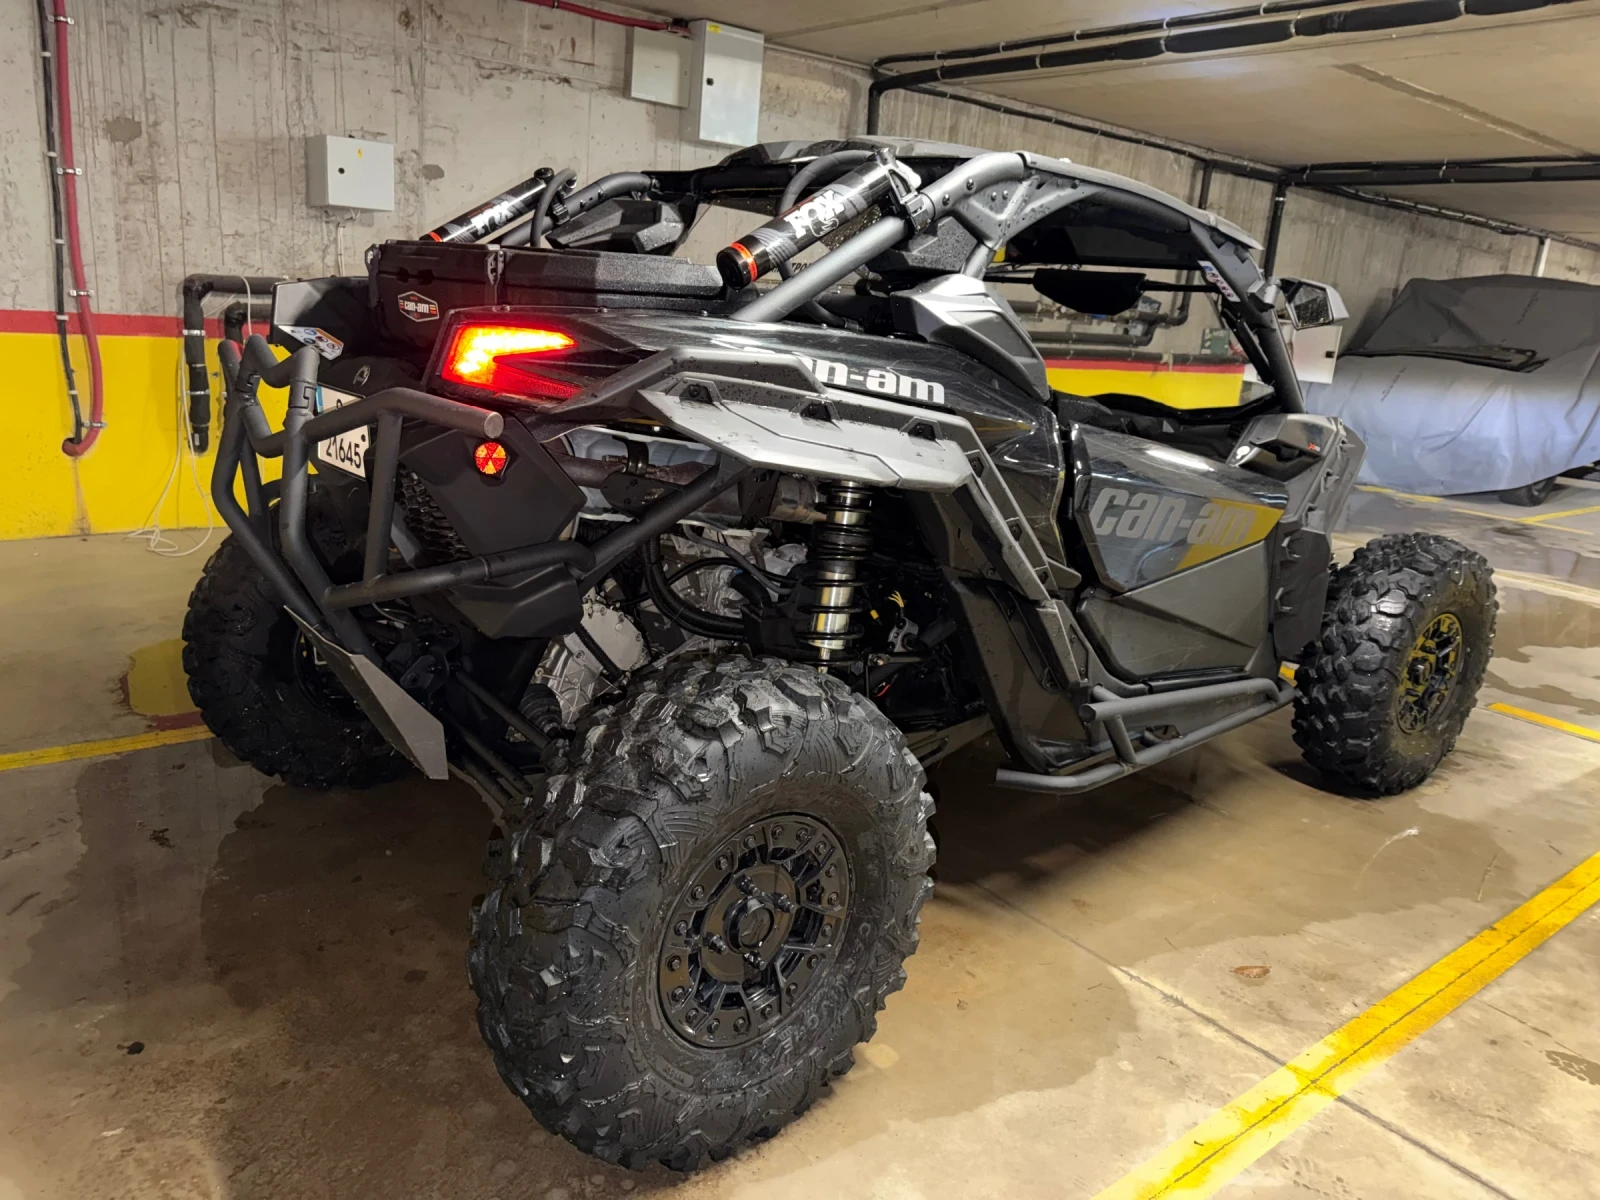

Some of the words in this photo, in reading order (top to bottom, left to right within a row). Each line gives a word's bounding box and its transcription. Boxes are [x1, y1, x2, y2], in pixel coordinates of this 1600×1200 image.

[783, 189, 845, 239] FOX
[793, 352, 945, 405] n-am
[325, 434, 362, 469] 21645
[1089, 487, 1256, 548] can-am
